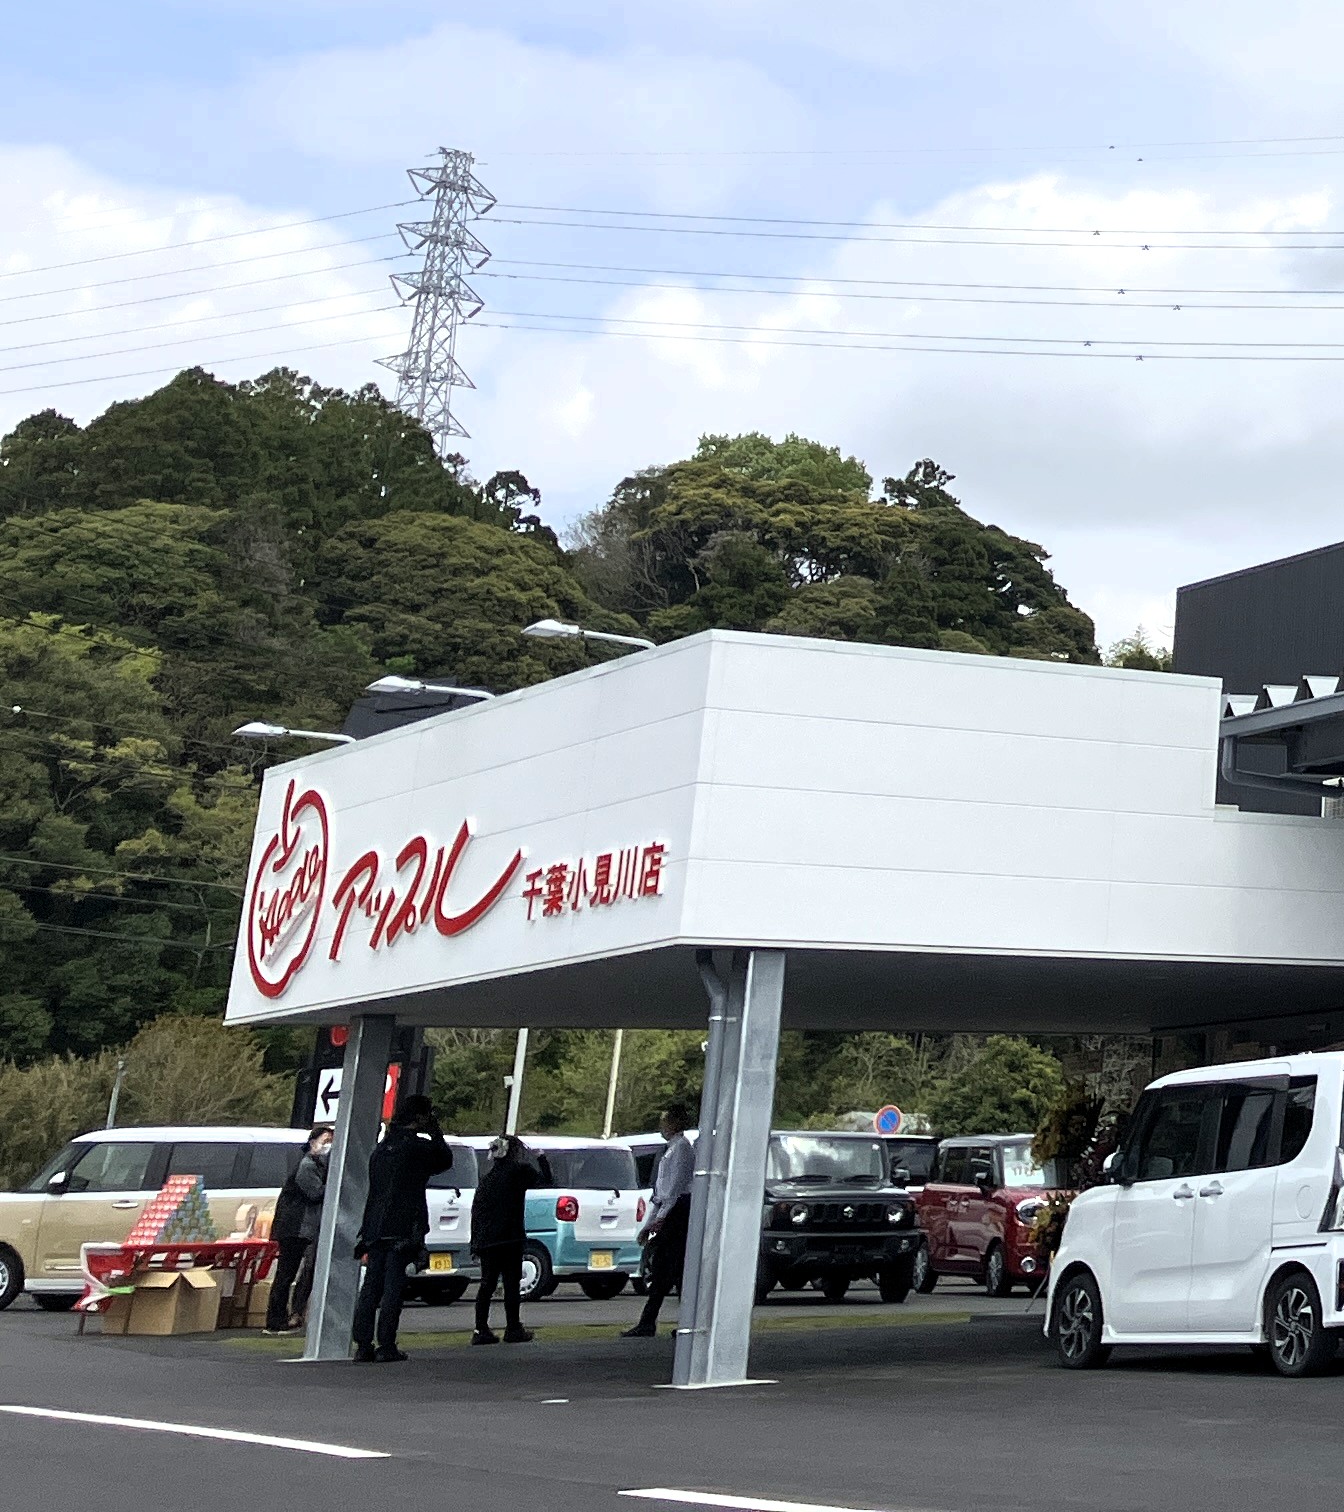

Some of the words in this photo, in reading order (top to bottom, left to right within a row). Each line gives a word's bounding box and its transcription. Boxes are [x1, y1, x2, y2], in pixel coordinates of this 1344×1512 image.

[329, 818, 522, 960] アップル
[522, 841, 665, 921] 千葉小見川店
